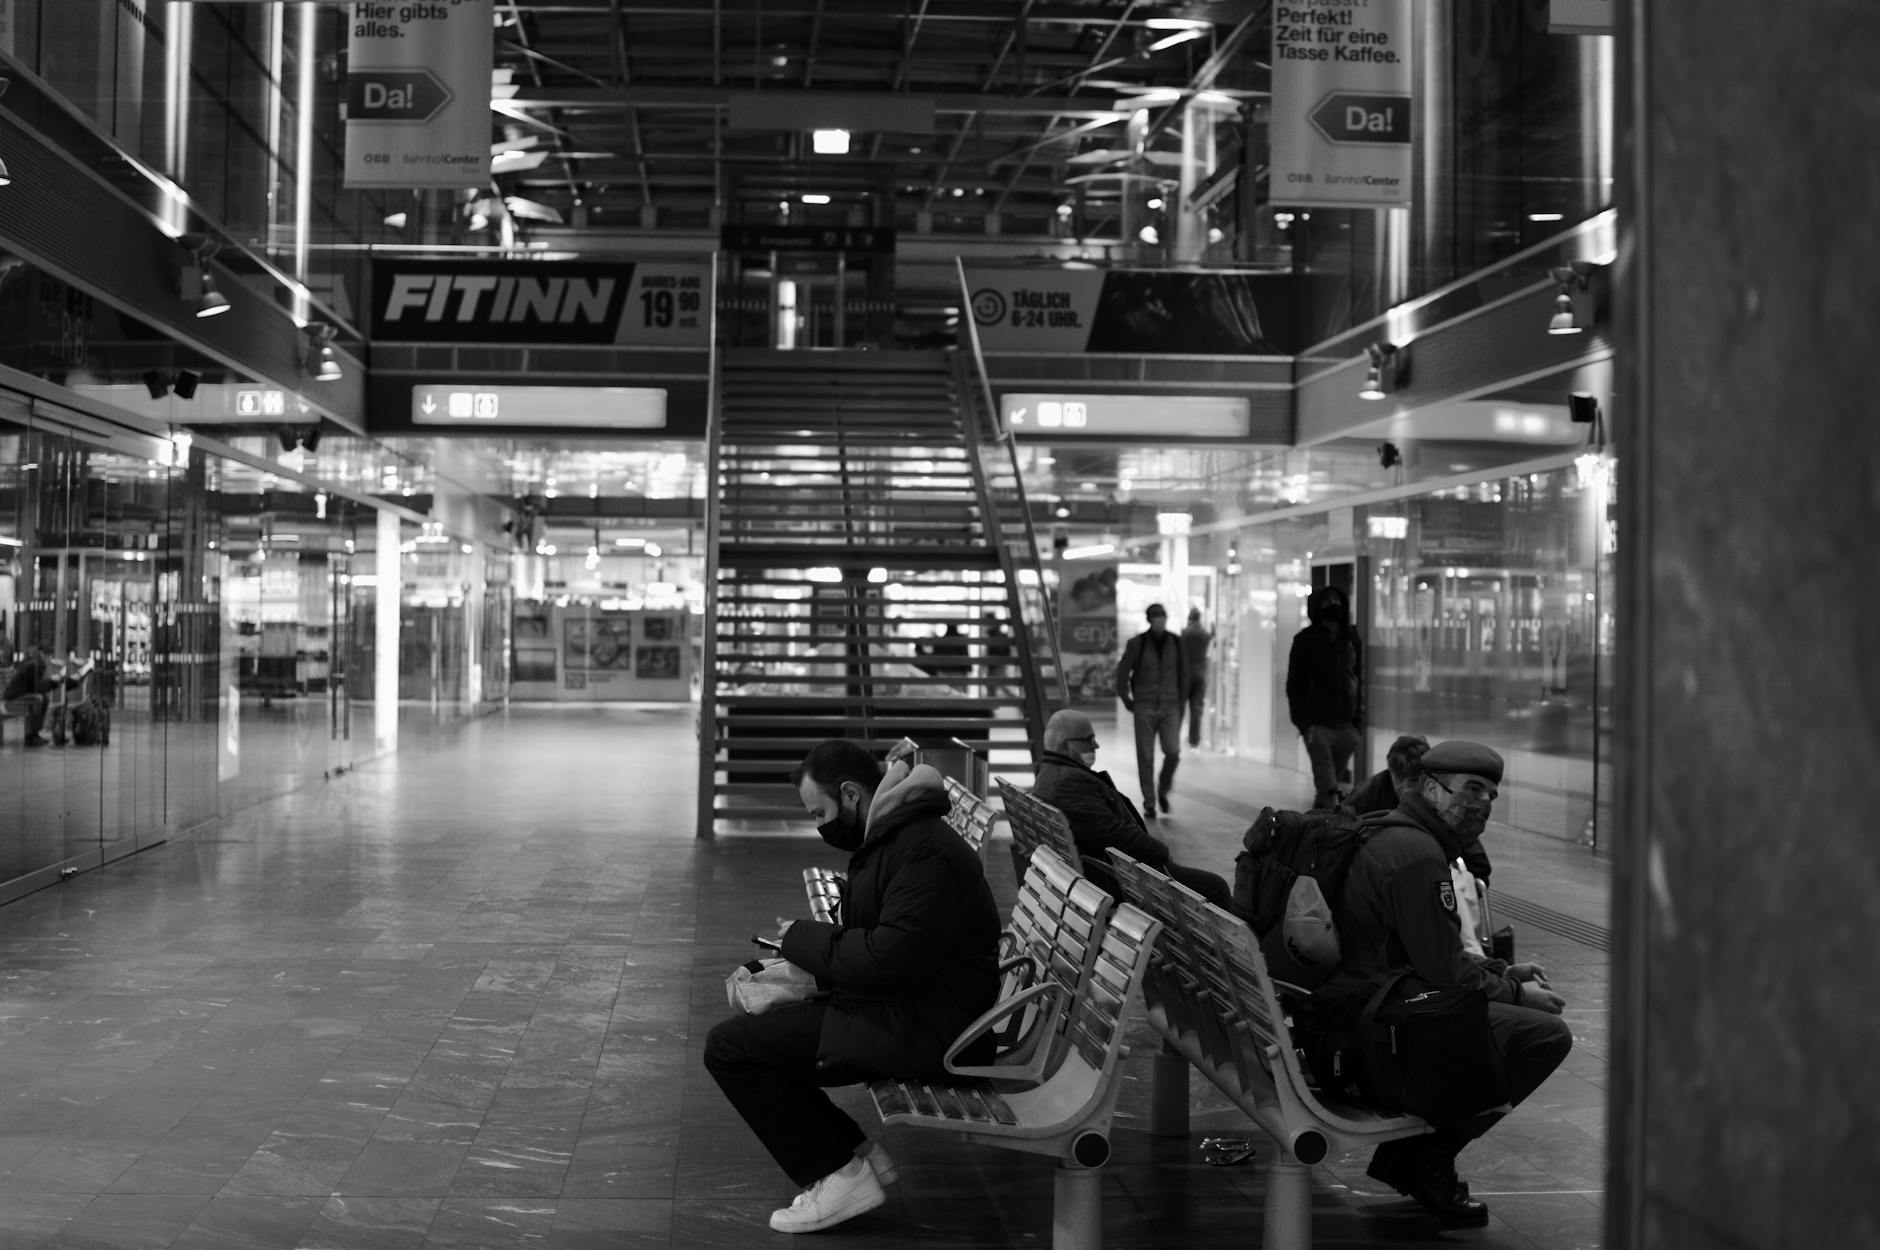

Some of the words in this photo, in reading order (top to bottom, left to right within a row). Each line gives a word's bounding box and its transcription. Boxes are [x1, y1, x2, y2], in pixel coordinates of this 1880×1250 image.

[355, 3, 394, 19] Hier
[400, 3, 448, 22] gibts
[1276, 7, 1353, 25] Perfekt!
[354, 21, 404, 38] alles.
[1276, 25, 1312, 42] Zeit
[1317, 27, 1344, 43] für
[1348, 28, 1388, 45] eine
[1276, 43, 1330, 61] Tasse
[1335, 46, 1401, 63] Kaffee.
[364, 82, 413, 109] Da!
[1346, 106, 1393, 132] Da!
[384, 275, 616, 323] FITINN
[1011, 288, 1071, 309] TÄGLICH
[640, 290, 674, 328] 19
[678, 291, 700, 311] 90
[1011, 310, 1045, 327] 6-24
[1049, 311, 1083, 328] UHR.
